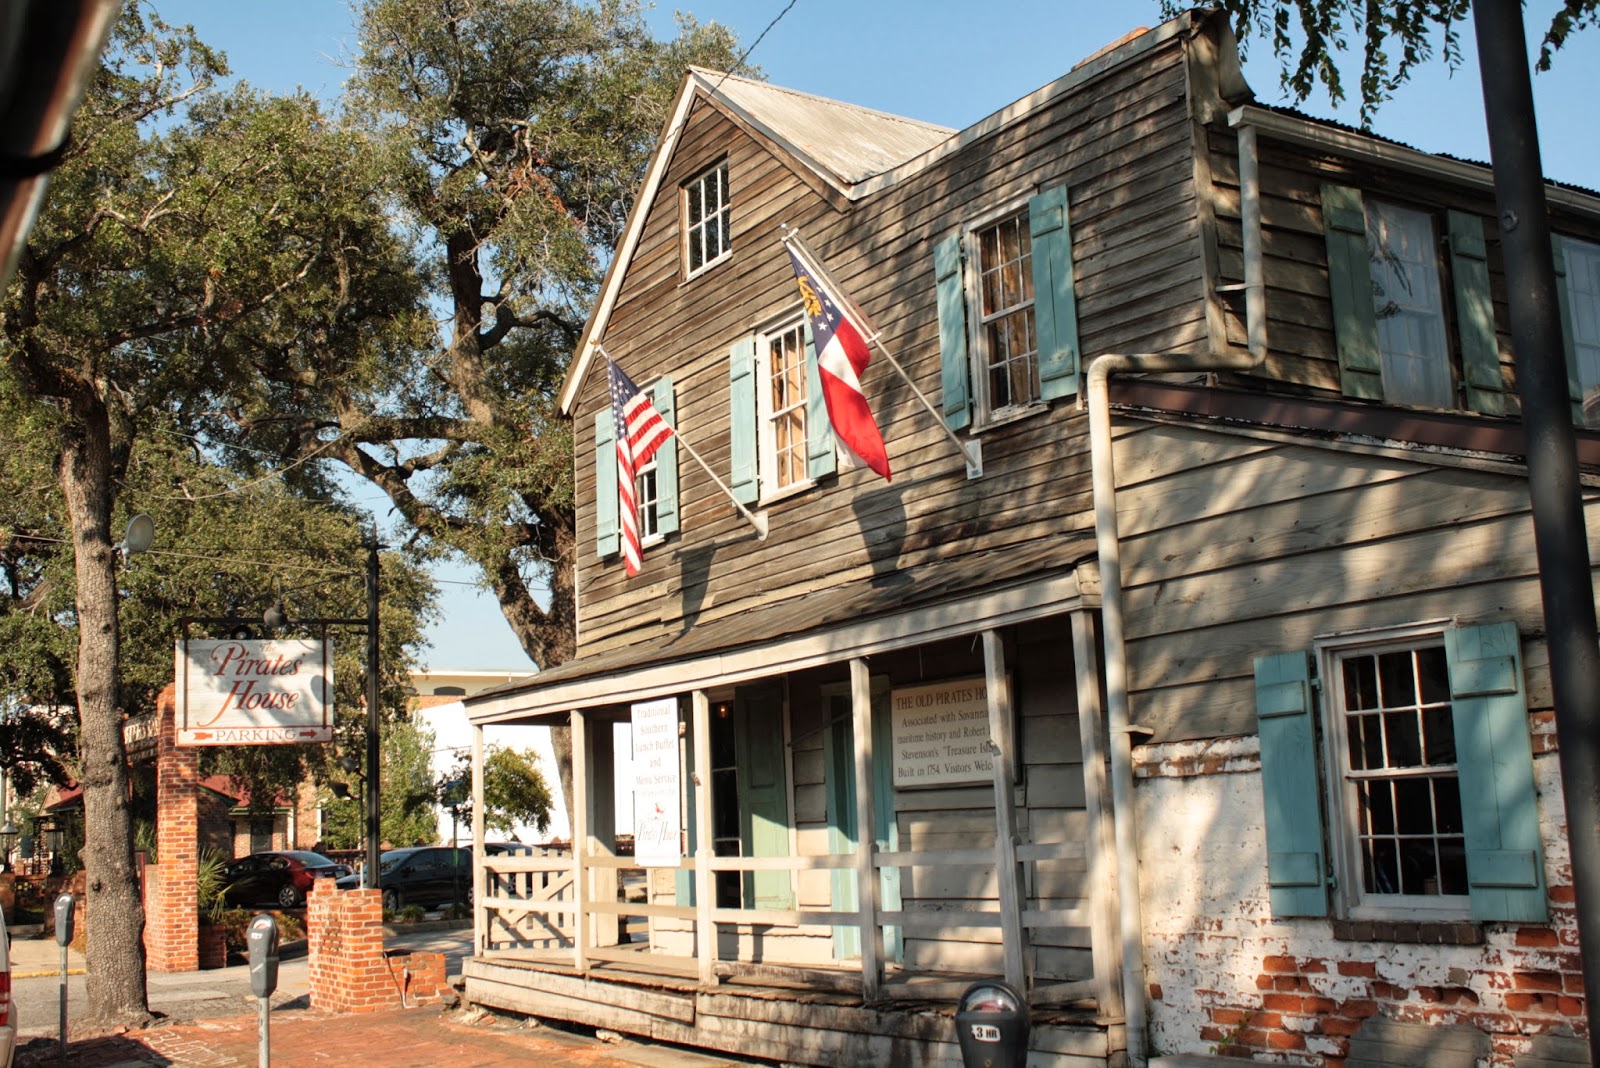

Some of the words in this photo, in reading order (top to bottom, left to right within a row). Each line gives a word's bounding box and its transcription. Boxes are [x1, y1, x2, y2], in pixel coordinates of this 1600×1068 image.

[196, 679, 299, 727] House
[896, 696, 913, 710] THE
[915, 694, 933, 708] OLD
[935, 688, 972, 705] PIRATES
[637, 704, 671, 719] Traditional
[902, 714, 937, 728] Associated
[940, 711, 956, 723] with
[958, 709, 989, 721] Savanna
[215, 729, 296, 741] PARKING
[640, 723, 668, 736] Southern
[896, 733, 924, 745] maritime
[925, 729, 947, 742] history
[949, 728, 961, 739] and
[963, 726, 986, 738] Robert
[635, 740, 654, 753] Lunch
[655, 737, 675, 751] Buffet
[901, 747, 939, 760] Stevenson's
[898, 766, 915, 778] Built
[917, 767, 925, 776] in
[944, 762, 972, 773] Visitors
[974, 760, 993, 771] Welc
[976, 1026, 983, 1038] 3
[985, 1028, 997, 1039] HR
